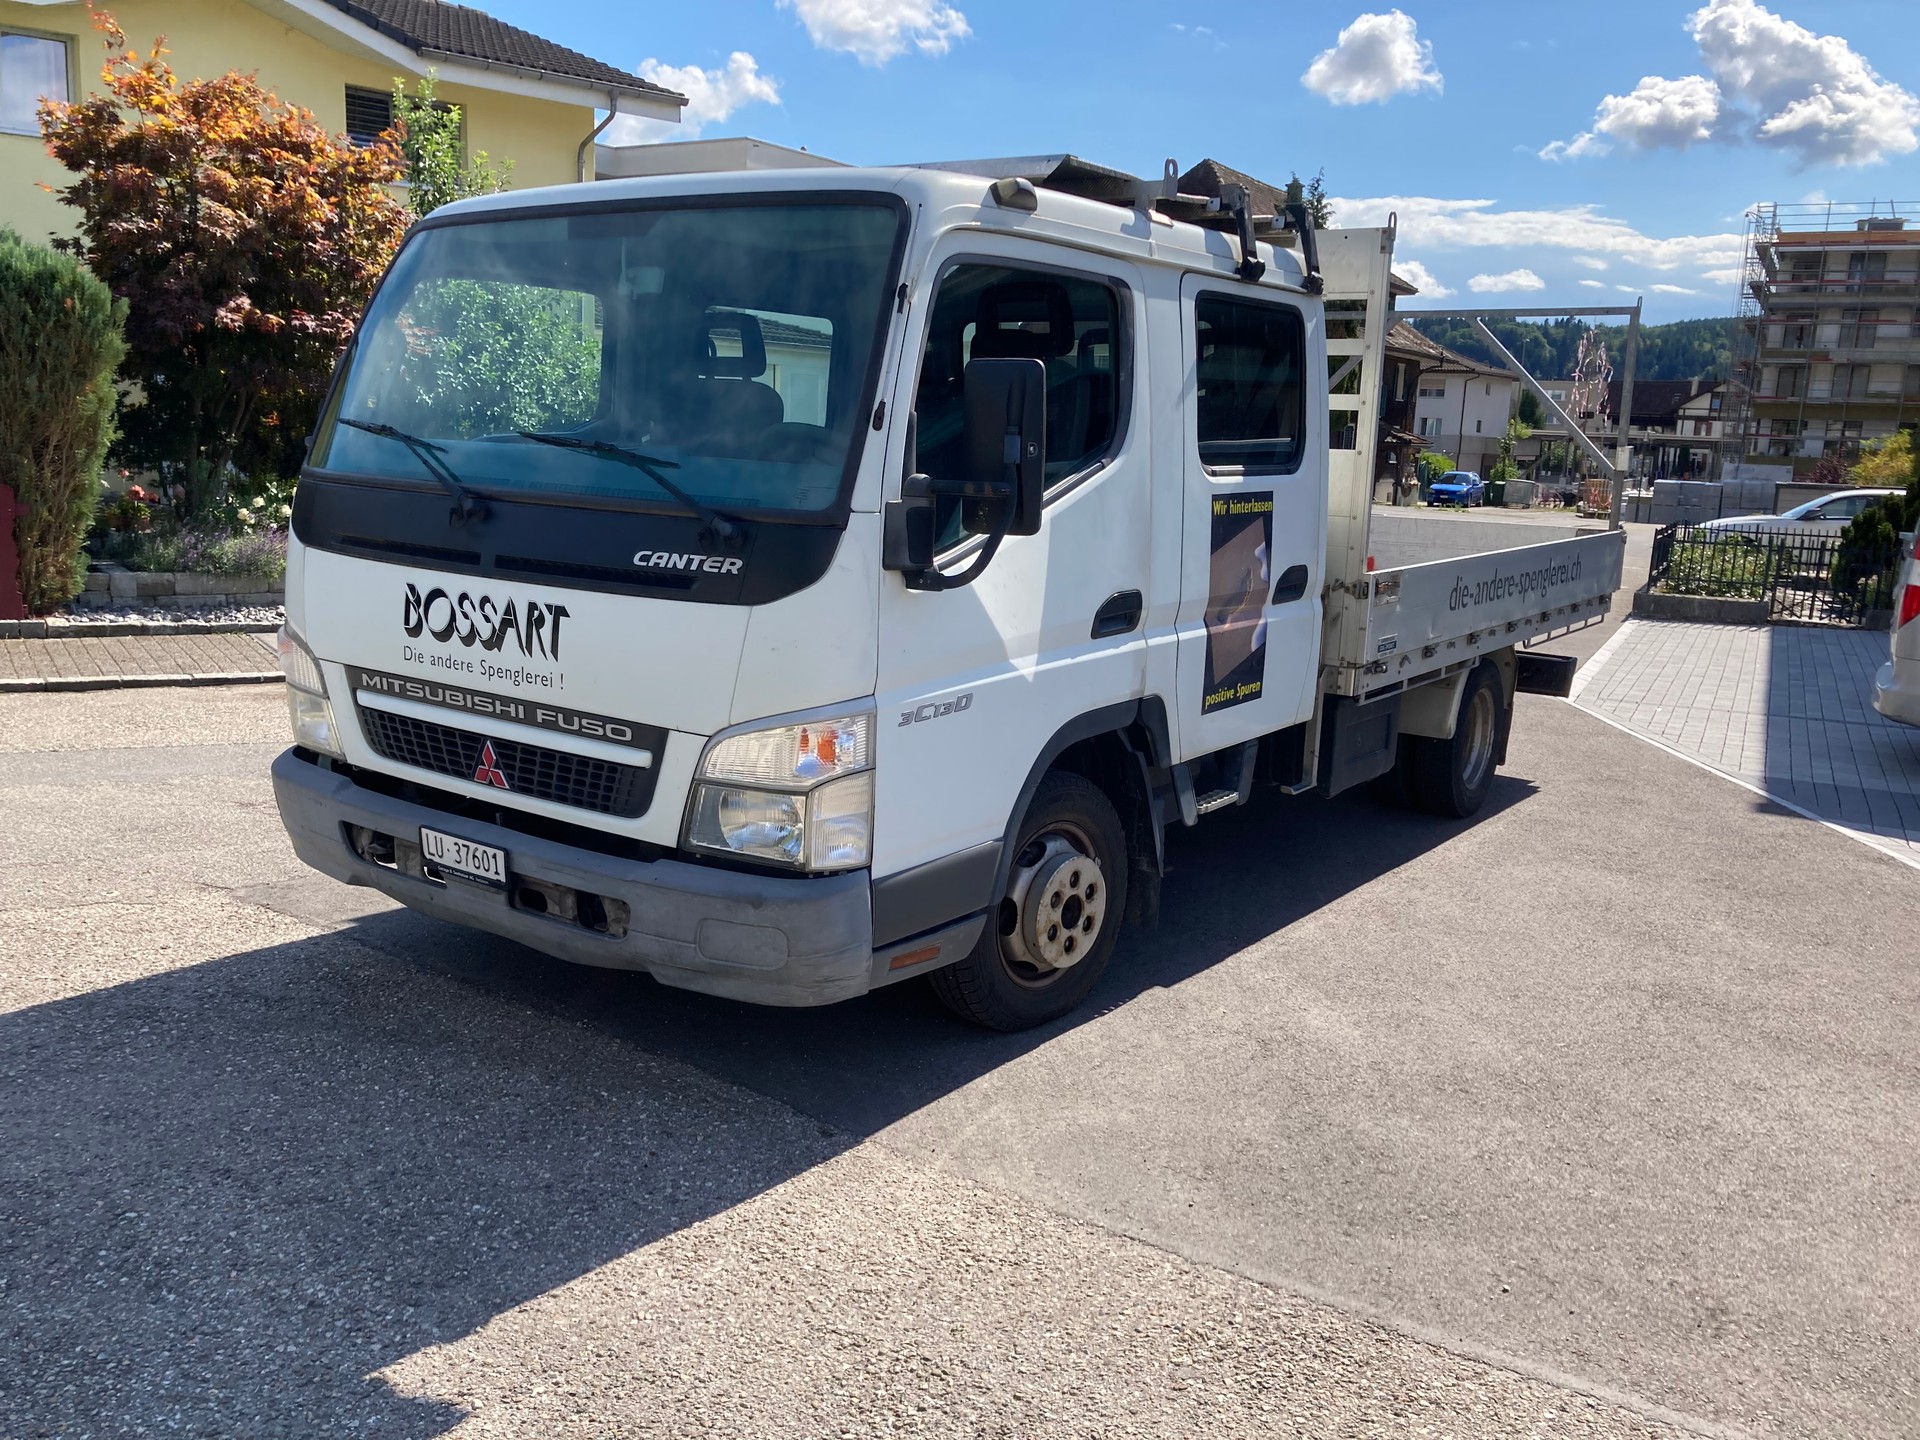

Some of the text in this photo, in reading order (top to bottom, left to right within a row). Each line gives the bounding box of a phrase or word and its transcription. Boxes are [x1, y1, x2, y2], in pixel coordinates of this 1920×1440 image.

[1213, 498, 1273, 515] Wir hinterlassen
[633, 550, 743, 575] CANTER
[1449, 552, 1582, 611] die-andere-spenglerei.ch
[404, 582, 571, 662] BOSSART
[403, 645, 425, 664] Die
[430, 653, 474, 673] andere
[480, 659, 553, 688] Spenglerei
[361, 672, 632, 742] MITSUBISHI FUSO
[898, 693, 974, 727] 3C13D
[1205, 681, 1261, 710] positive Spuren
